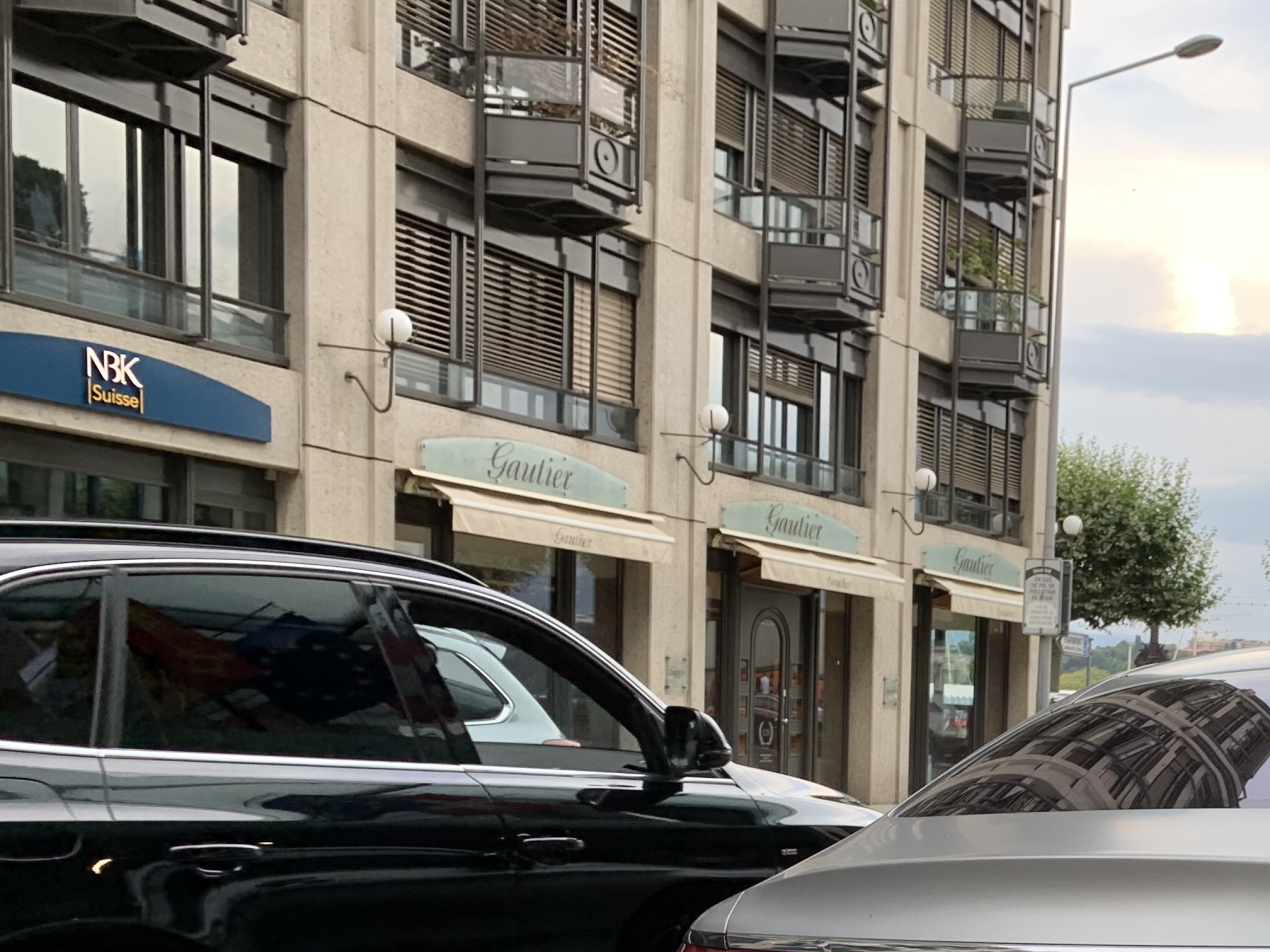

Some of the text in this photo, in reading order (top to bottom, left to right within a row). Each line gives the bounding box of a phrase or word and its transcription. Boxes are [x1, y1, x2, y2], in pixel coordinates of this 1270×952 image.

[86, 347, 143, 388] NBK
[92, 385, 139, 411] Suisse
[485, 441, 574, 490] Gautier
[553, 526, 592, 549] Gautier
[765, 502, 824, 540] Gautier
[953, 546, 995, 577] Gautier
